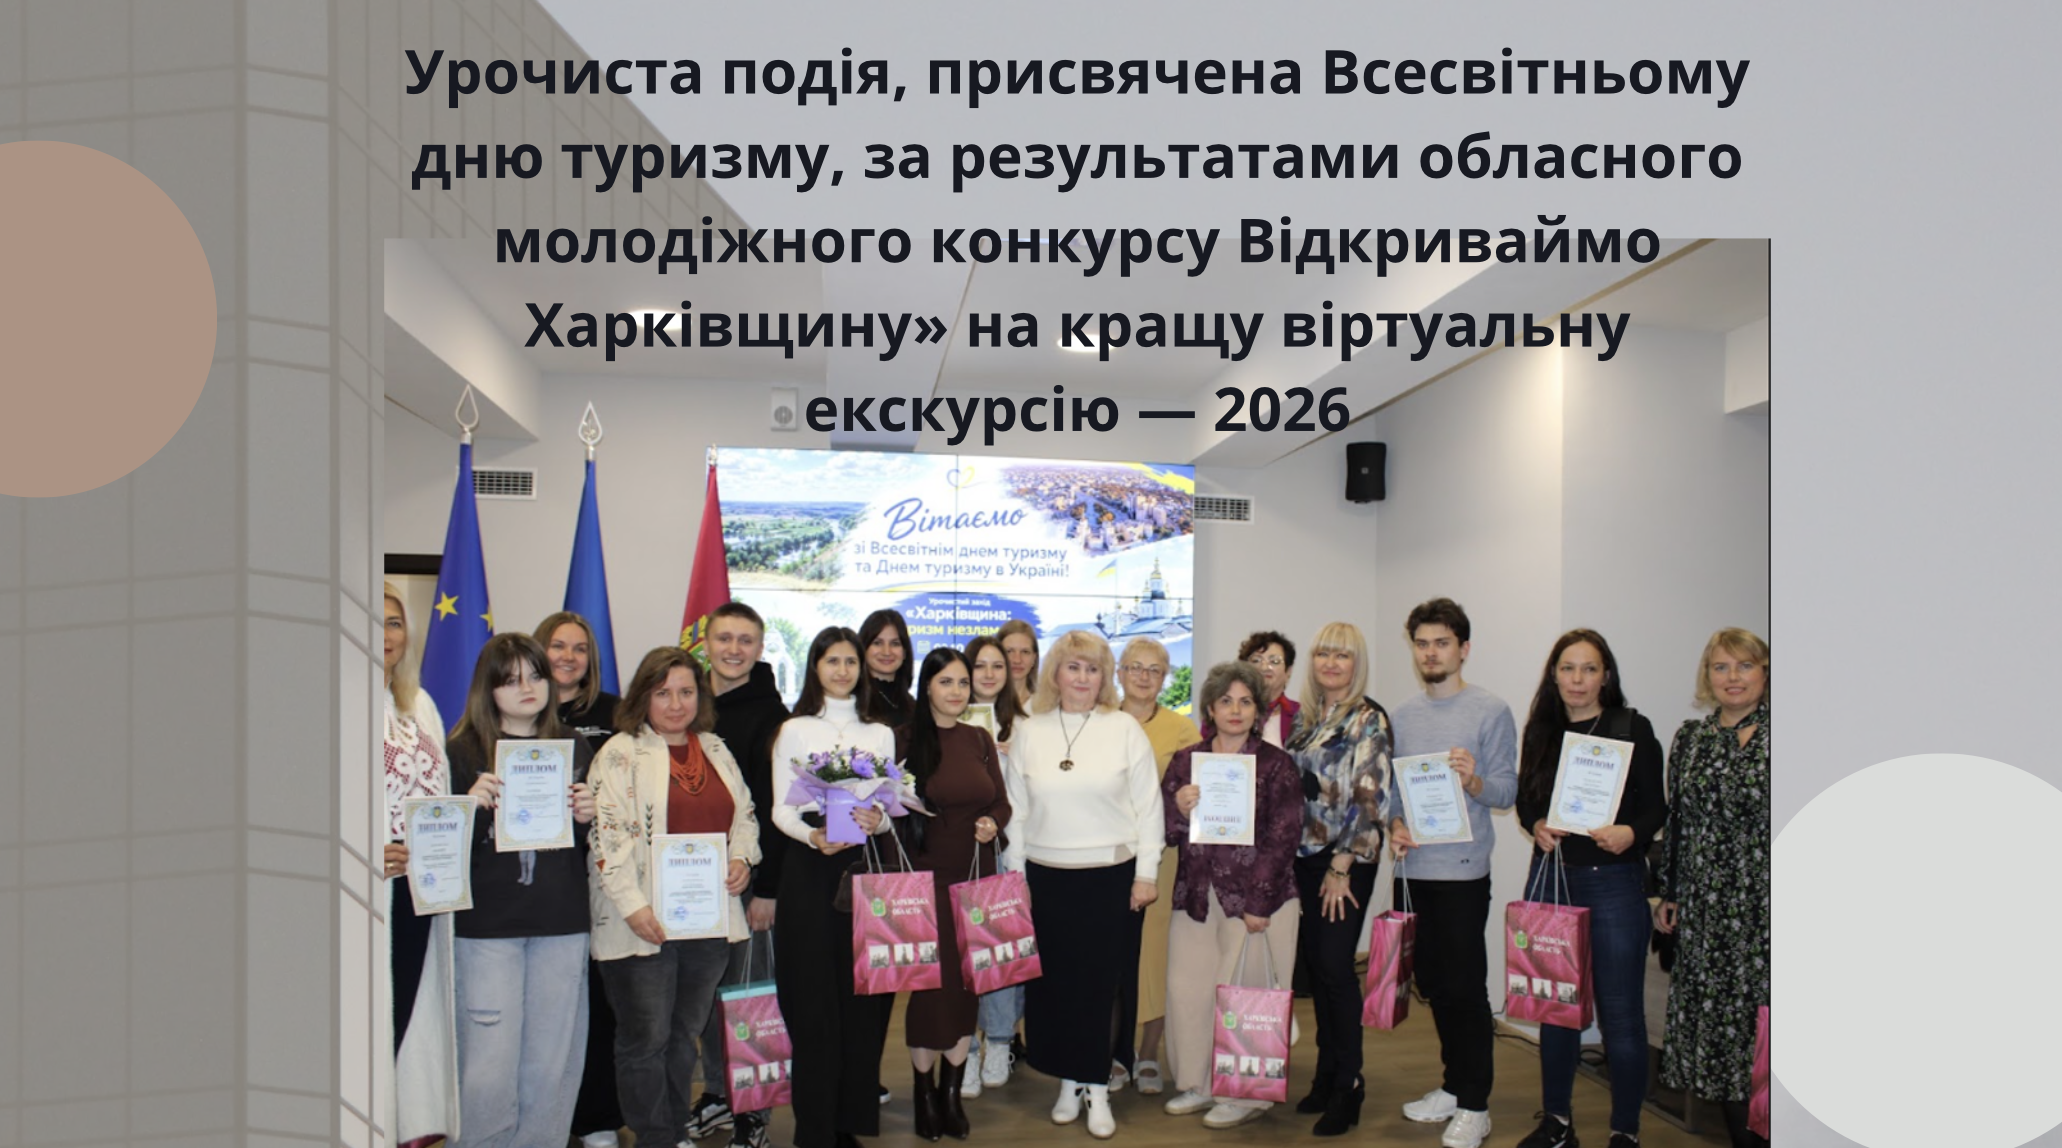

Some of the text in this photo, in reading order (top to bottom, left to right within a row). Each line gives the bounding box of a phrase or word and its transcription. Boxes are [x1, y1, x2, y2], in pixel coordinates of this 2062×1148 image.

[883, 497, 1028, 541] Вітаємо
[854, 541, 1068, 562] зі Всесвітнім днем туризму
[855, 560, 1070, 578] та Днем туризму в Україні!
[905, 605, 1012, 623] «Харківщина:
[907, 624, 1001, 637] ризм незлам
